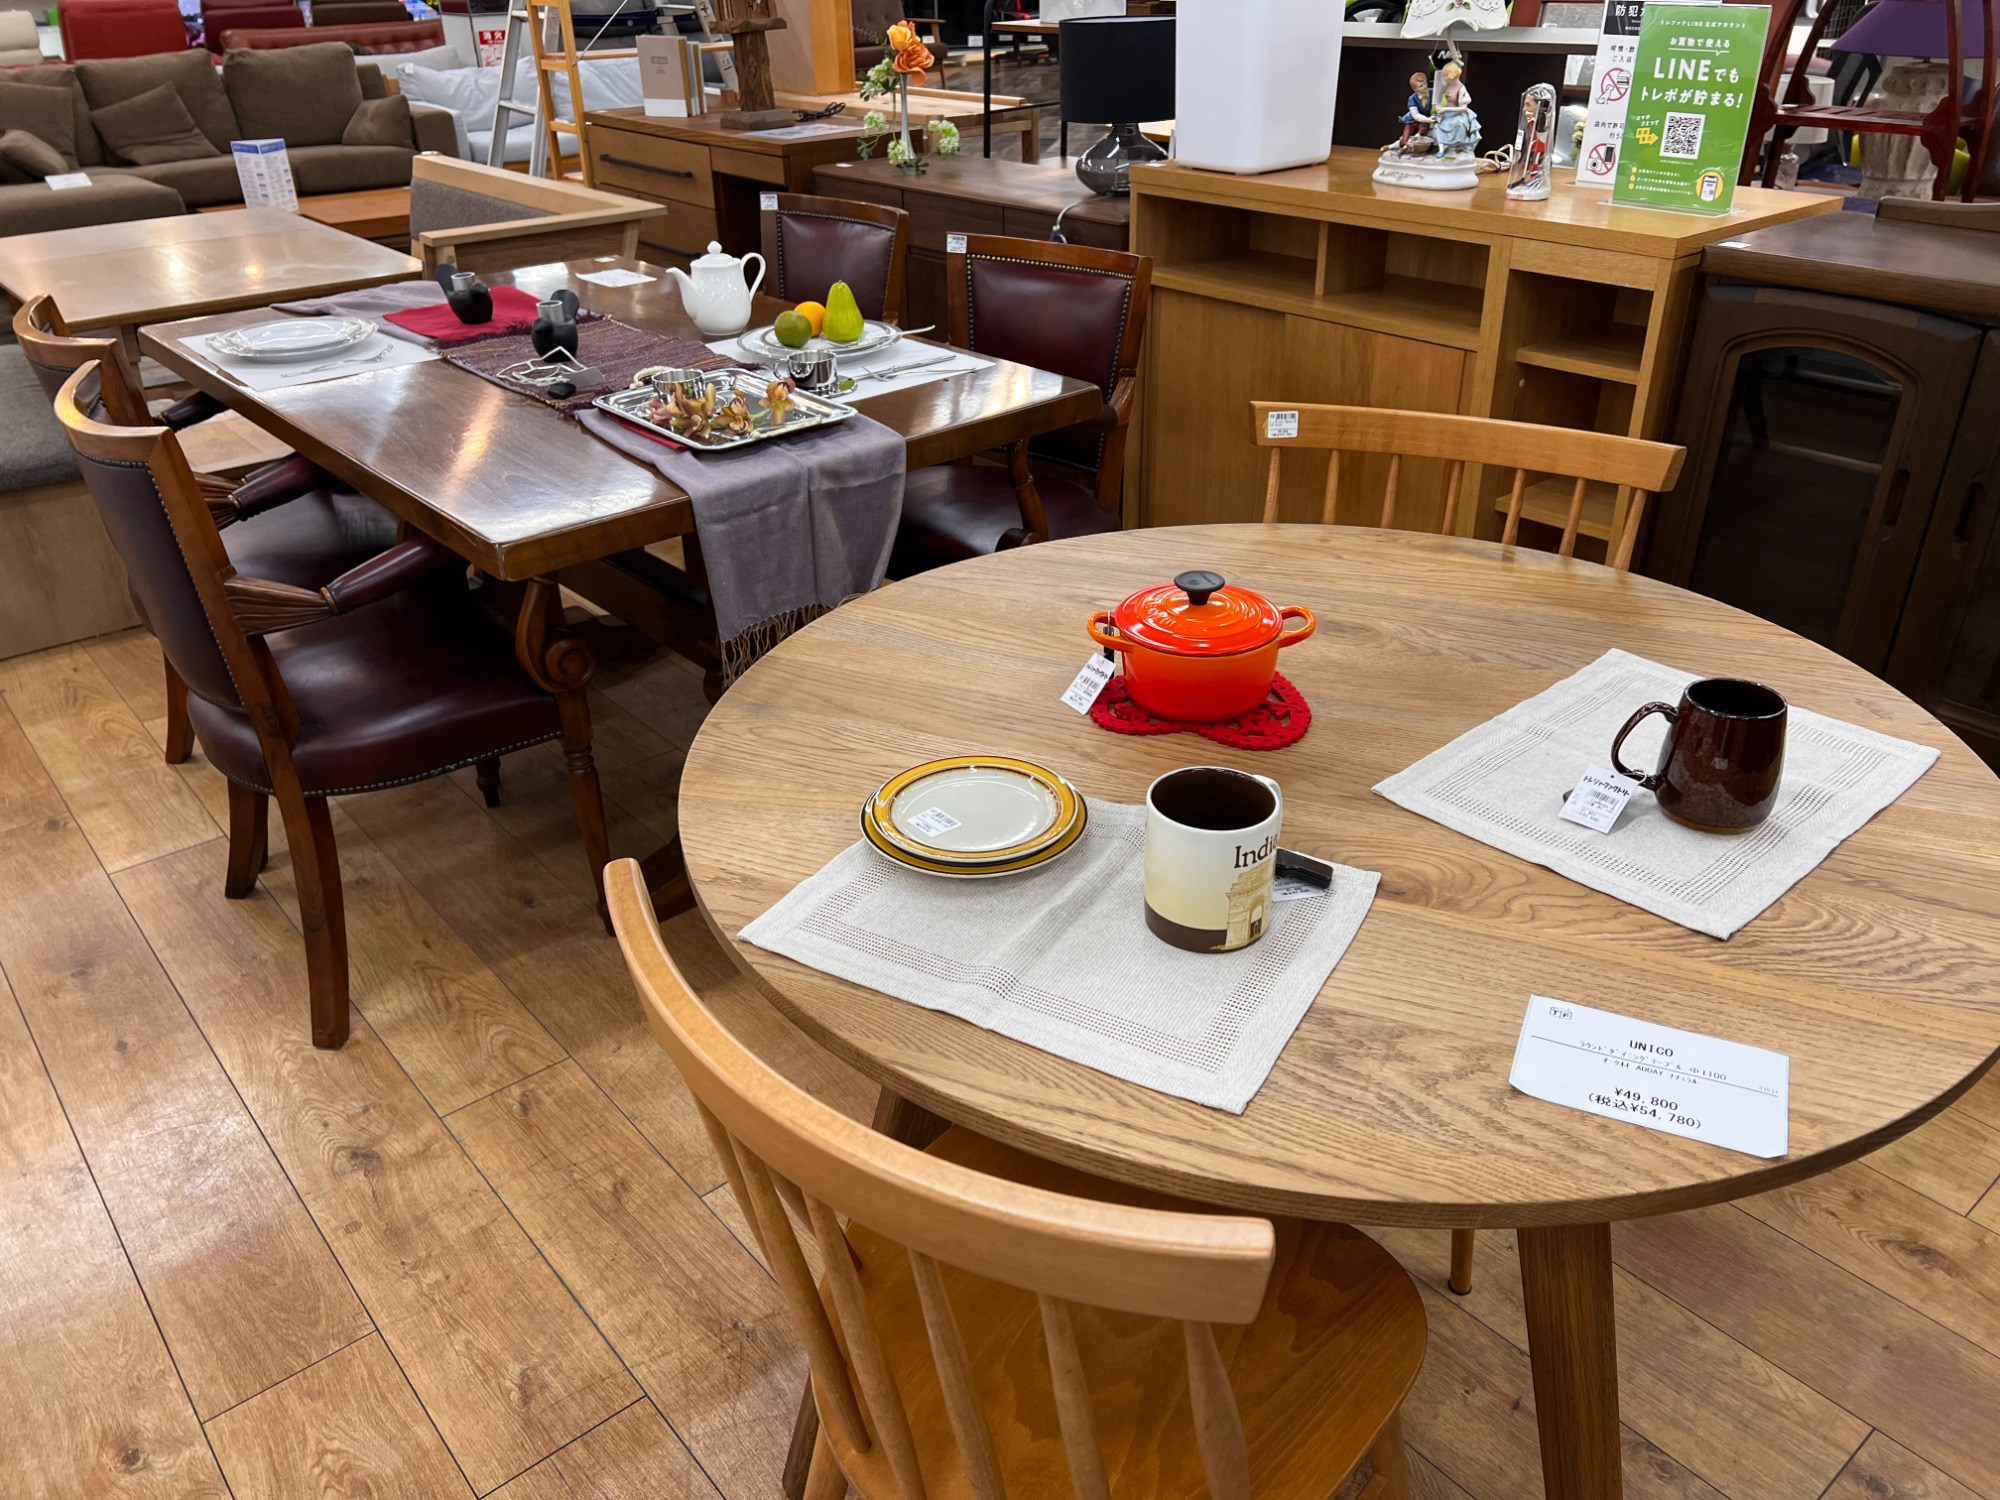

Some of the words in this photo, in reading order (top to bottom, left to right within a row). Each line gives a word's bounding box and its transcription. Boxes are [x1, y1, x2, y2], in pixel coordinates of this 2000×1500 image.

[1669, 36, 1731, 48] お買物で使える
[1653, 57, 1739, 83] LINEでも
[1629, 1039, 1674, 1058] UNICO
